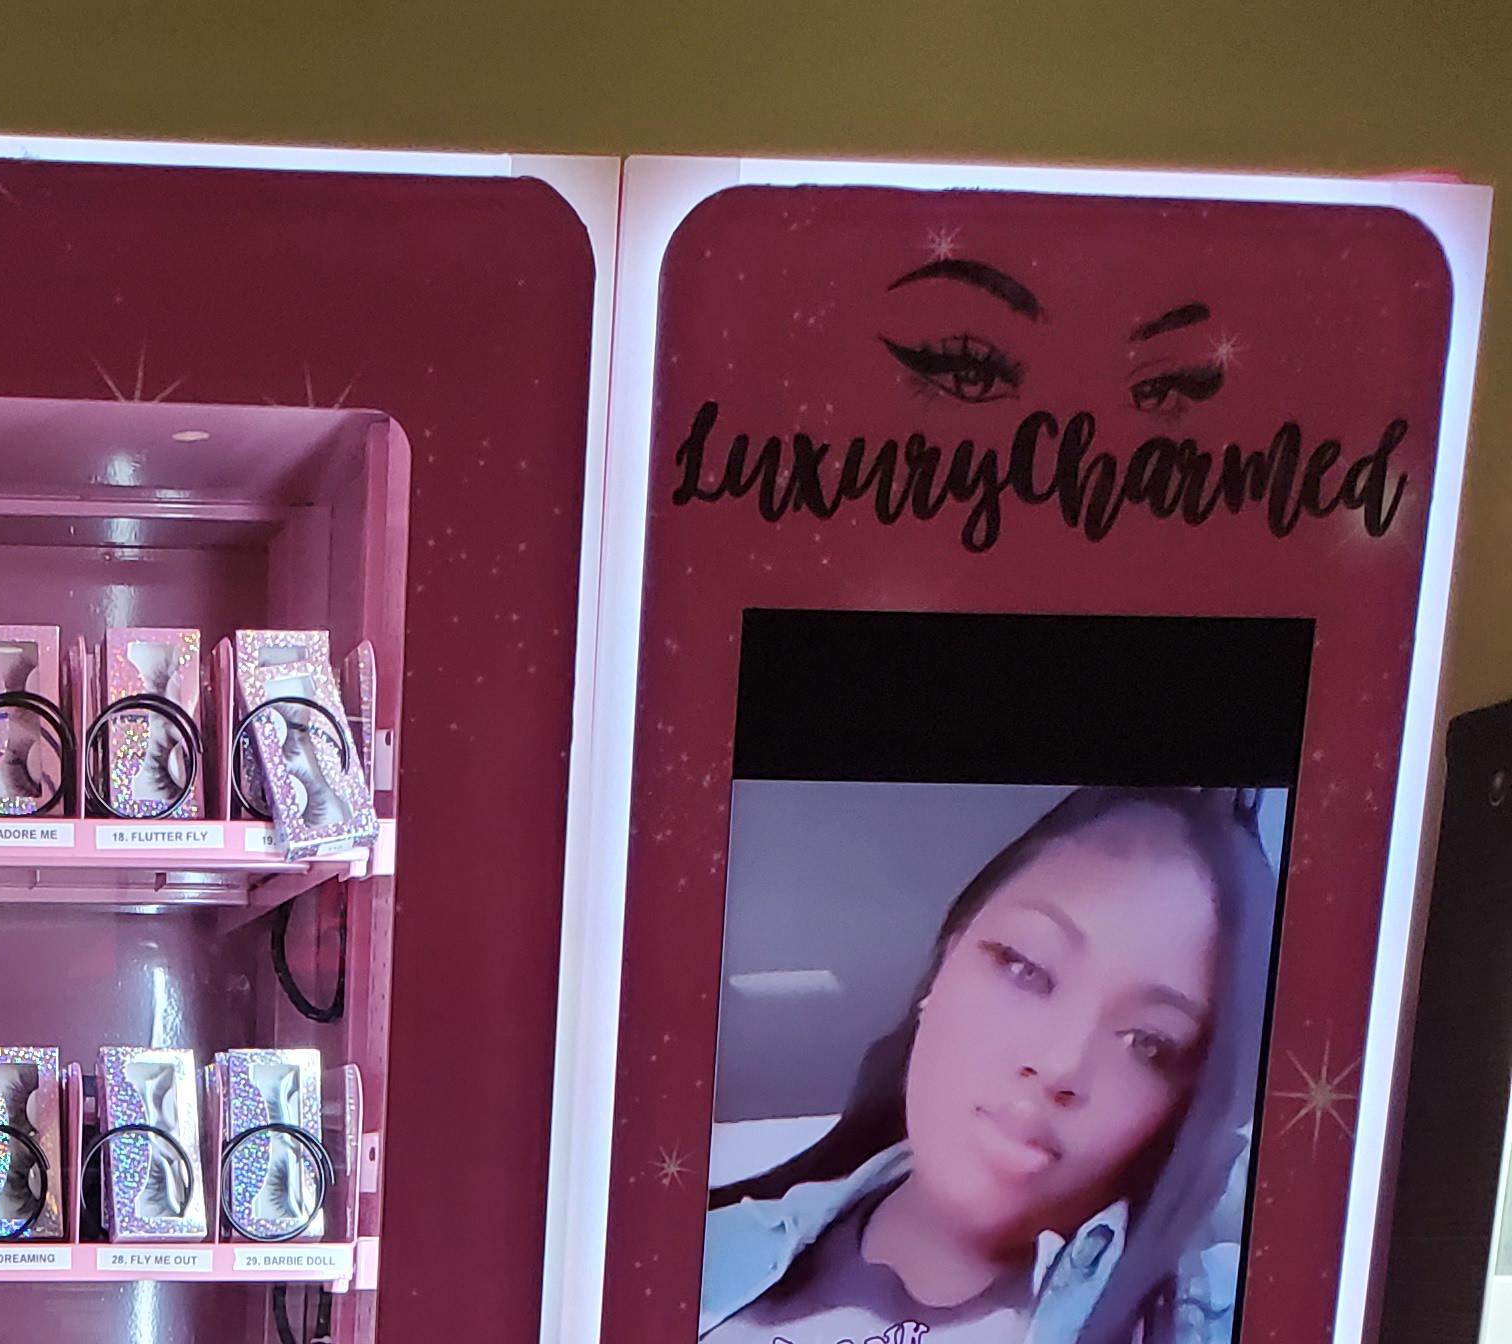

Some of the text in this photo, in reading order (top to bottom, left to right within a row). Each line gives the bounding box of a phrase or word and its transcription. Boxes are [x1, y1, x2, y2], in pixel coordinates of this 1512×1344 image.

[672, 399, 1409, 553] LuxuryCharmed
[41, 829, 57, 840] ME
[113, 831, 208, 842] 18. FLUTTER FLY
[112, 1254, 197, 1265] 28. FLY ME OUT
[246, 1255, 335, 1266] 29. BARBIE DOLL
